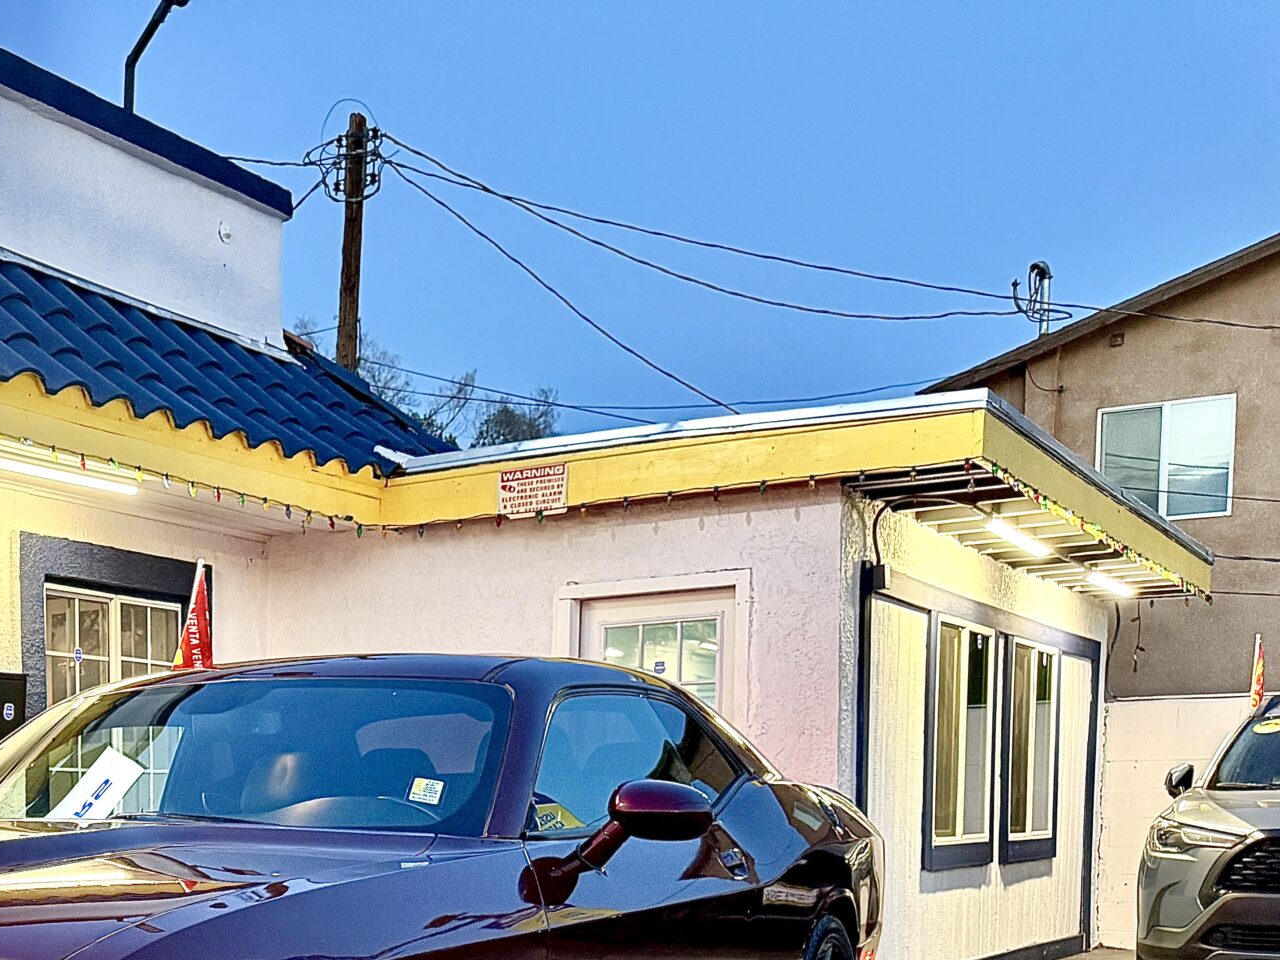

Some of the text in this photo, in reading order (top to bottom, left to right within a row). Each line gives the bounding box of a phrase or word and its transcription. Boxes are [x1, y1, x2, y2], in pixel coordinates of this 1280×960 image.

[502, 465, 564, 481] WARNING
[536, 477, 564, 485] PREMISES
[529, 485, 555, 493] SECURED
[501, 490, 563, 503] ELECTRONIC ALARM
[510, 501, 533, 509] CLOSED
[535, 497, 561, 506] CIRCUIT
[191, 647, 203, 670] VEN
